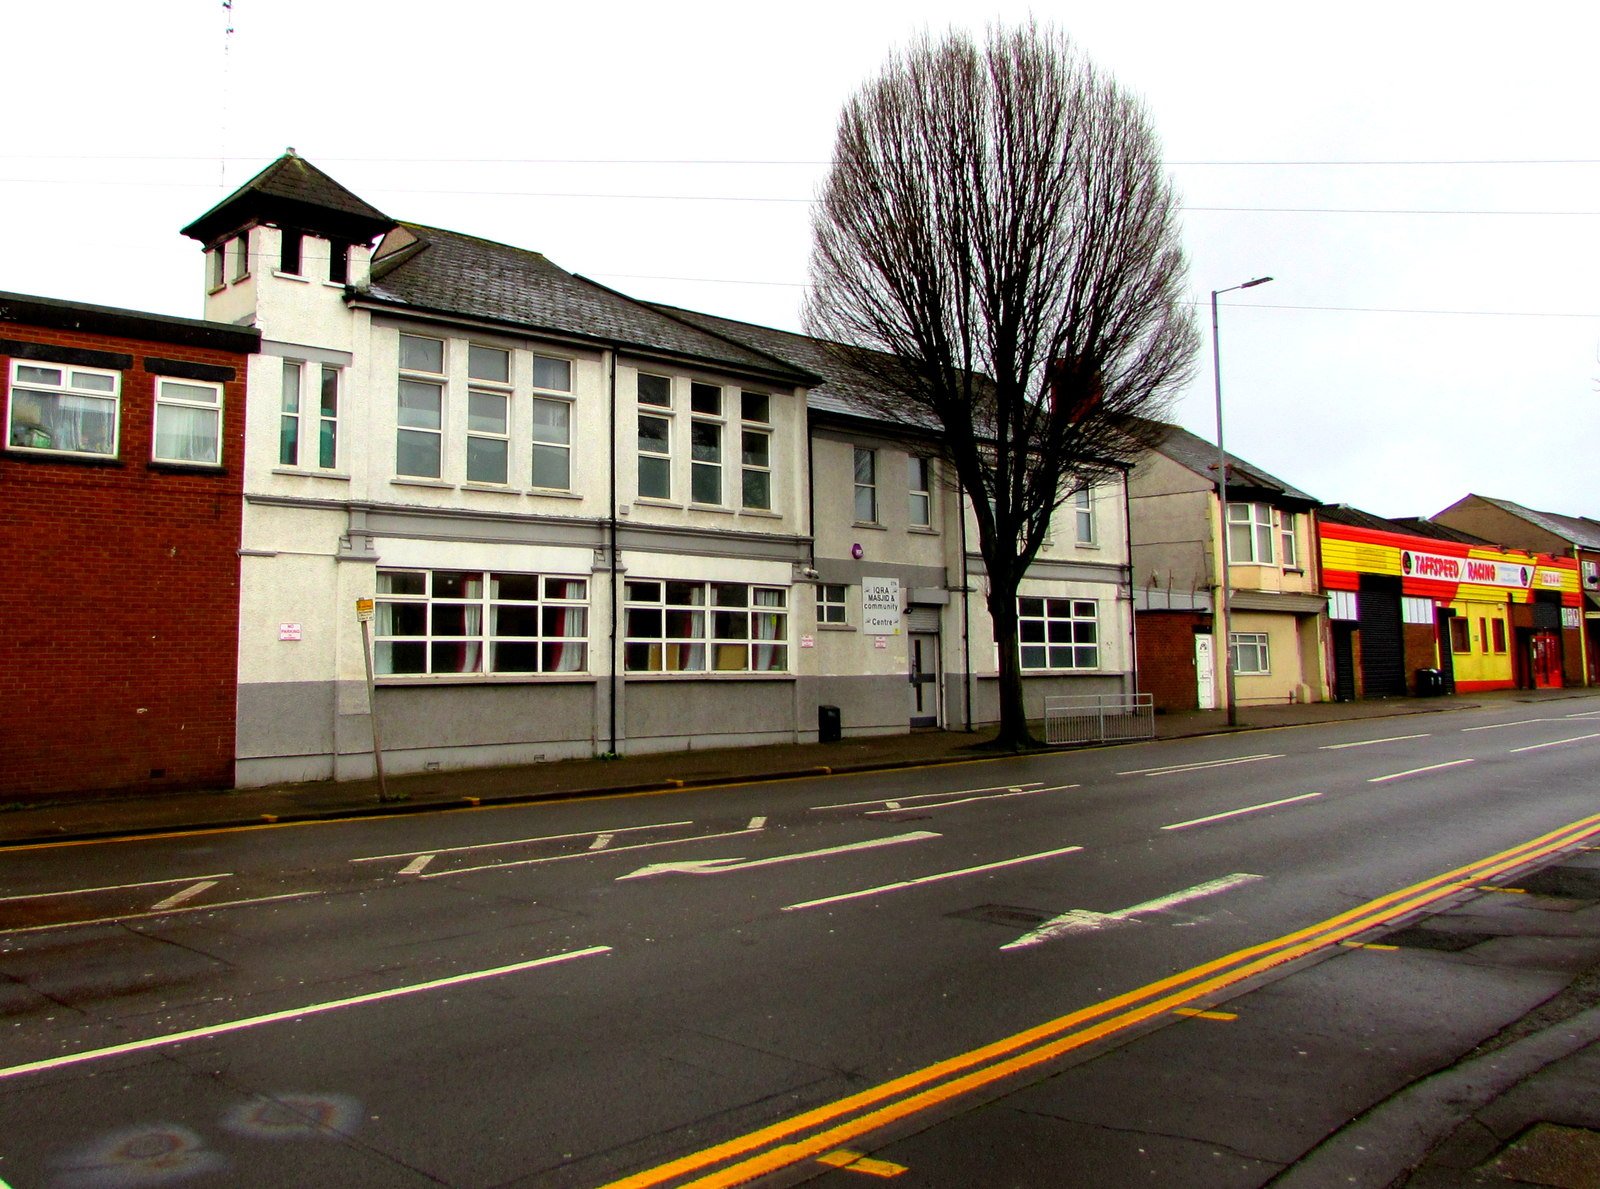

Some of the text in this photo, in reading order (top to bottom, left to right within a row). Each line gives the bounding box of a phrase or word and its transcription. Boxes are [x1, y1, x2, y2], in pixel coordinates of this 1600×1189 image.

[1414, 555, 1459, 578] TAFFSPEED
[1467, 561, 1495, 581] RACING
[868, 594, 889, 602] MASJID
[864, 603, 898, 611] community
[872, 618, 892, 626] Centre
